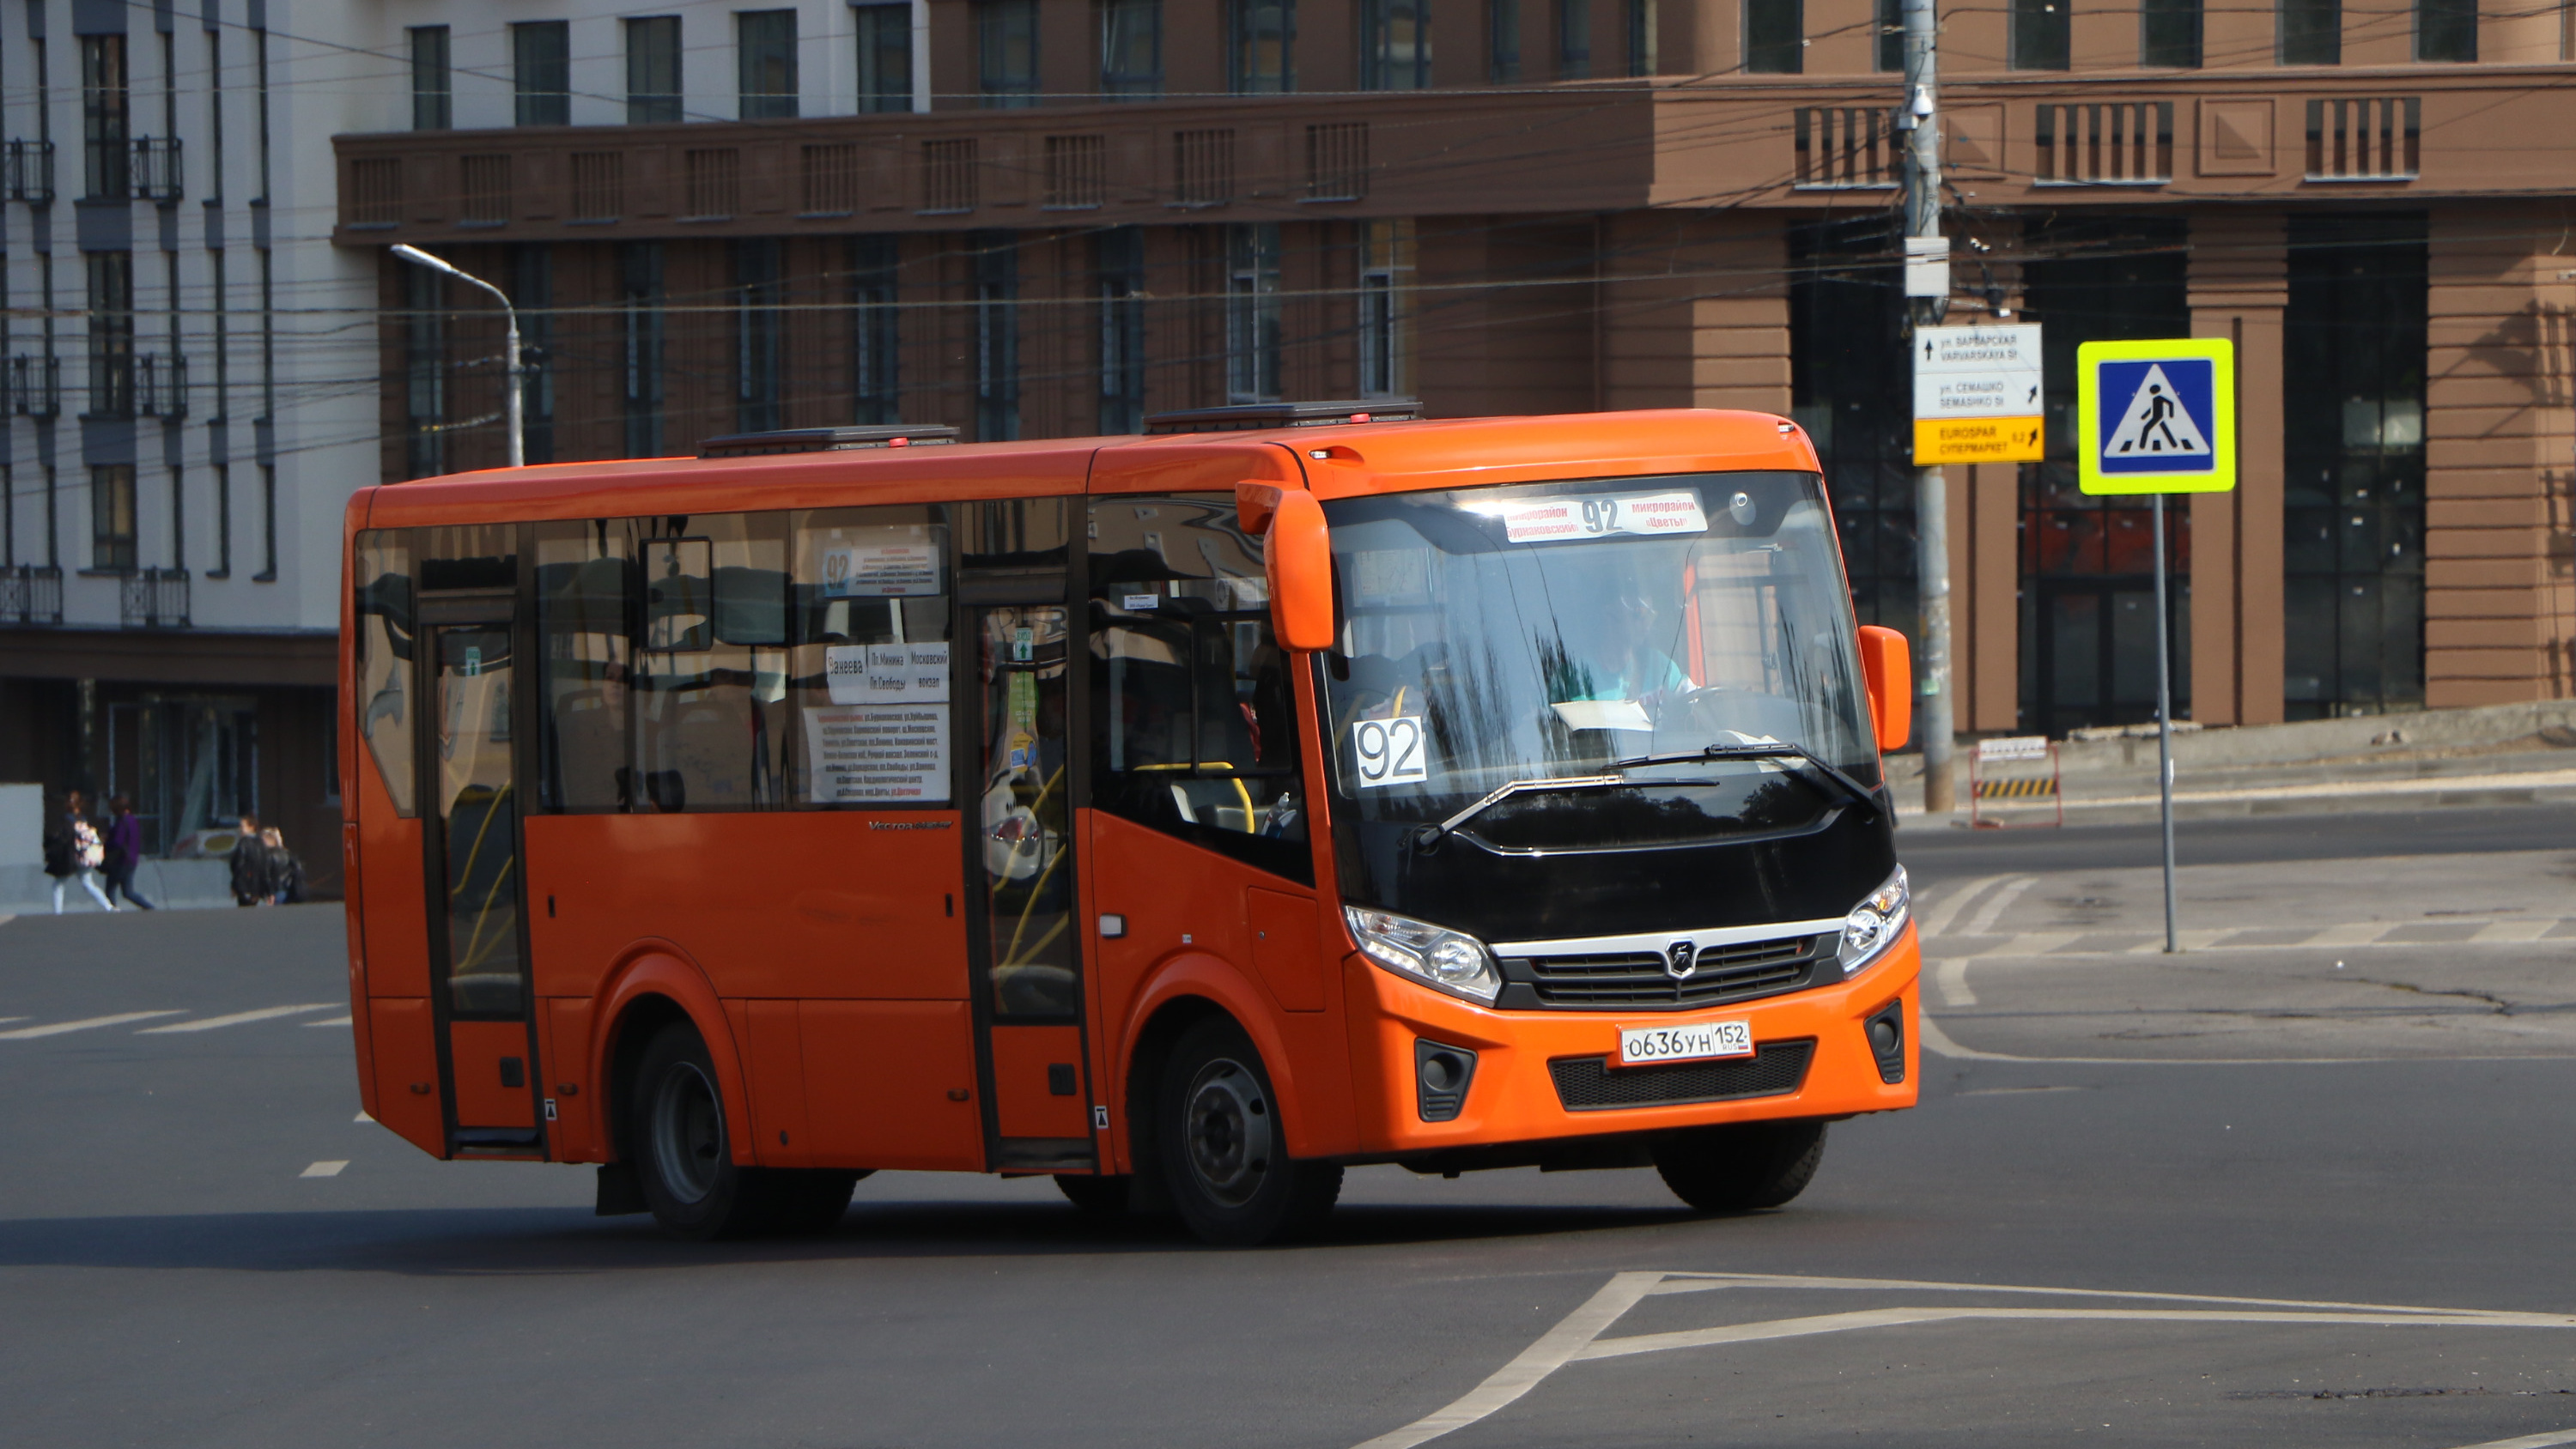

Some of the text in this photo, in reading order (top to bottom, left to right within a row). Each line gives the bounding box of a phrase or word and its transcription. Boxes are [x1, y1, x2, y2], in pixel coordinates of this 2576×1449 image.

[1955, 334, 2017, 347] ВАРВАРСКАЯ
[1941, 350, 2006, 361] VARVARSKAYA
[1956, 382, 2004, 393] СЕМАШКО
[1940, 397, 1992, 408] SEMASHKO
[1940, 426, 1997, 440] EUROSPAR
[1940, 442, 2008, 454] СУПЕРМАРКЕТ
[1631, 500, 1696, 513] микрорайон
[1582, 499, 1623, 533] 92
[827, 554, 849, 590] 92
[911, 650, 948, 665] Московский
[918, 676, 940, 688] вокзал
[1357, 718, 1424, 780] 92
[1715, 1024, 1745, 1044] 152
